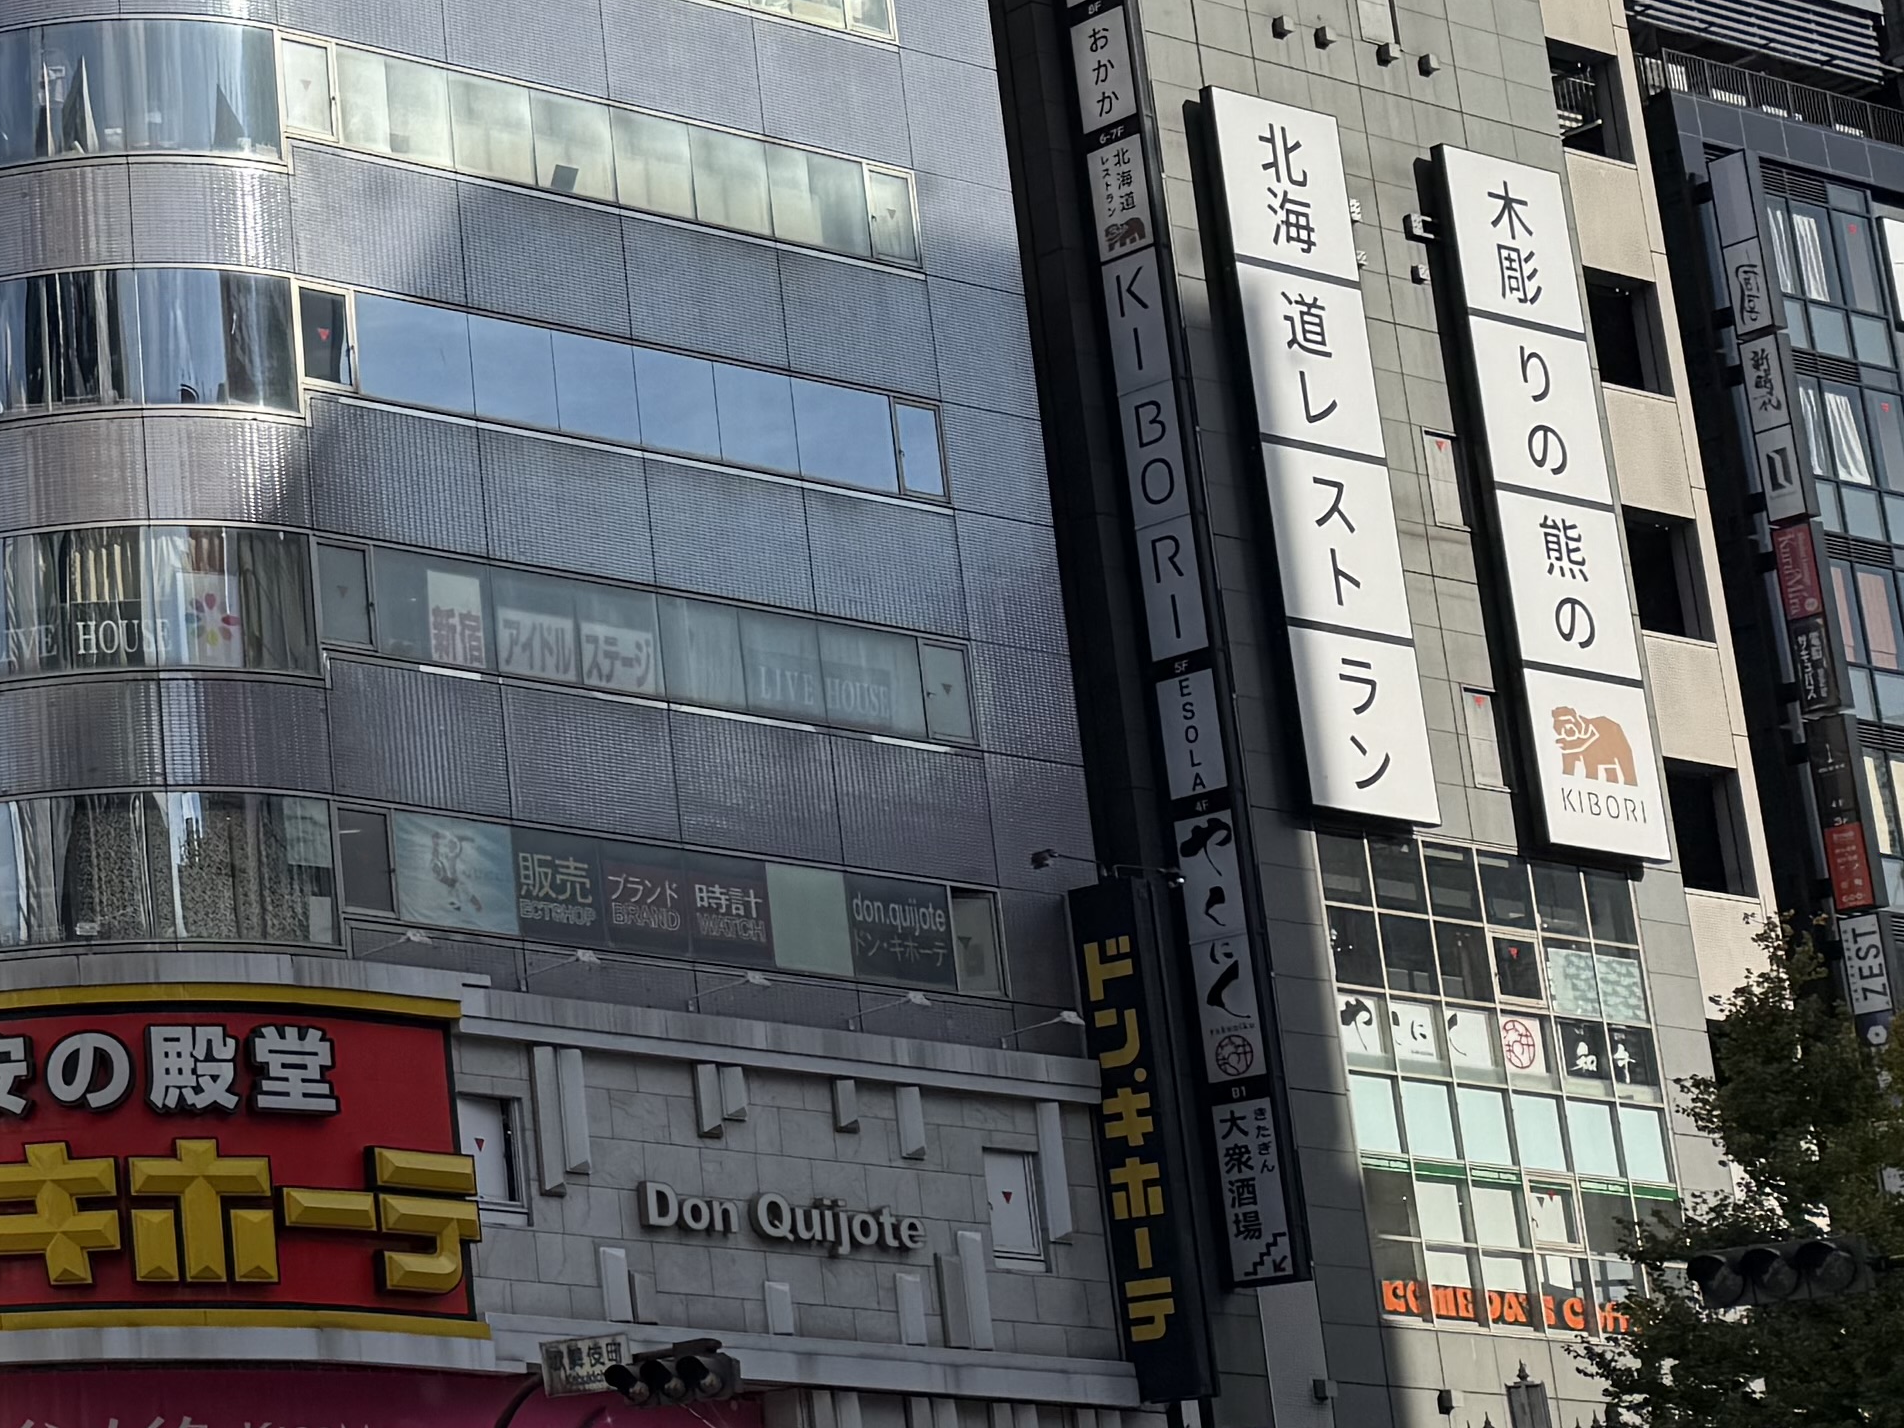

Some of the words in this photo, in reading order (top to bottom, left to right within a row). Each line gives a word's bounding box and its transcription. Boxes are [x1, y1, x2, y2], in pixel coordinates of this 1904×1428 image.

[1087, 27, 1120, 119] おかか
[1100, 155, 1117, 218] レストラン
[1113, 147, 1136, 213] 北海道
[1486, 179, 1597, 650] 木彫りの熊の
[1115, 265, 1184, 639] KIBORI
[1257, 122, 1392, 793] 北海道レストラン
[1178, 677, 1207, 793] ESOLA
[1561, 786, 1649, 826] KIBORI
[518, 852, 591, 903] 販売
[607, 873, 679, 906] ブランド
[694, 883, 764, 920] 時計
[611, 903, 681, 932] BRAND
[696, 913, 766, 944] WATCH
[852, 890, 948, 936] don.quijote
[1851, 927, 1889, 1003] ZEST
[1252, 1106, 1276, 1173] きたぎん
[1219, 1108, 1264, 1241] 大衆酒場
[638, 1180, 740, 1235] Don
[750, 1189, 930, 1257] Quijote
